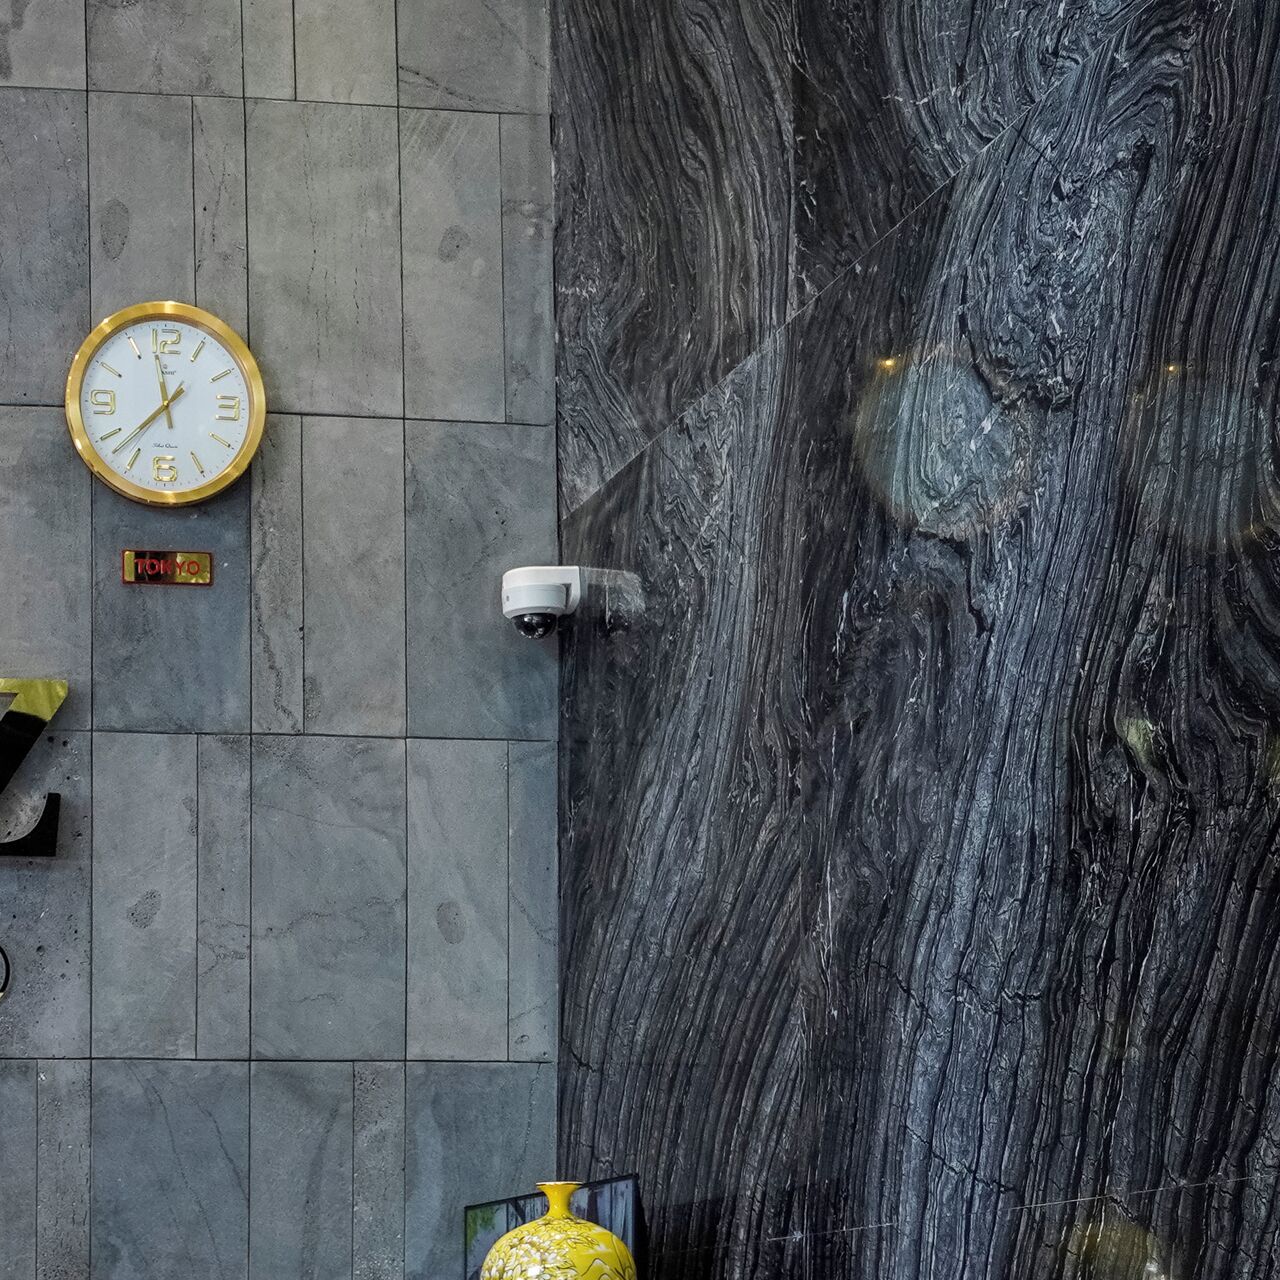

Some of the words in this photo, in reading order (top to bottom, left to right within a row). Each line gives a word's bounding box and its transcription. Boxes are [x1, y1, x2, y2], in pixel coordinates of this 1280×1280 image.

[151, 328, 181, 355] 12
[90, 389, 116, 415] 9
[215, 394, 240, 421] 3
[152, 455, 178, 482] 6
[134, 558, 201, 576] TOKYO
